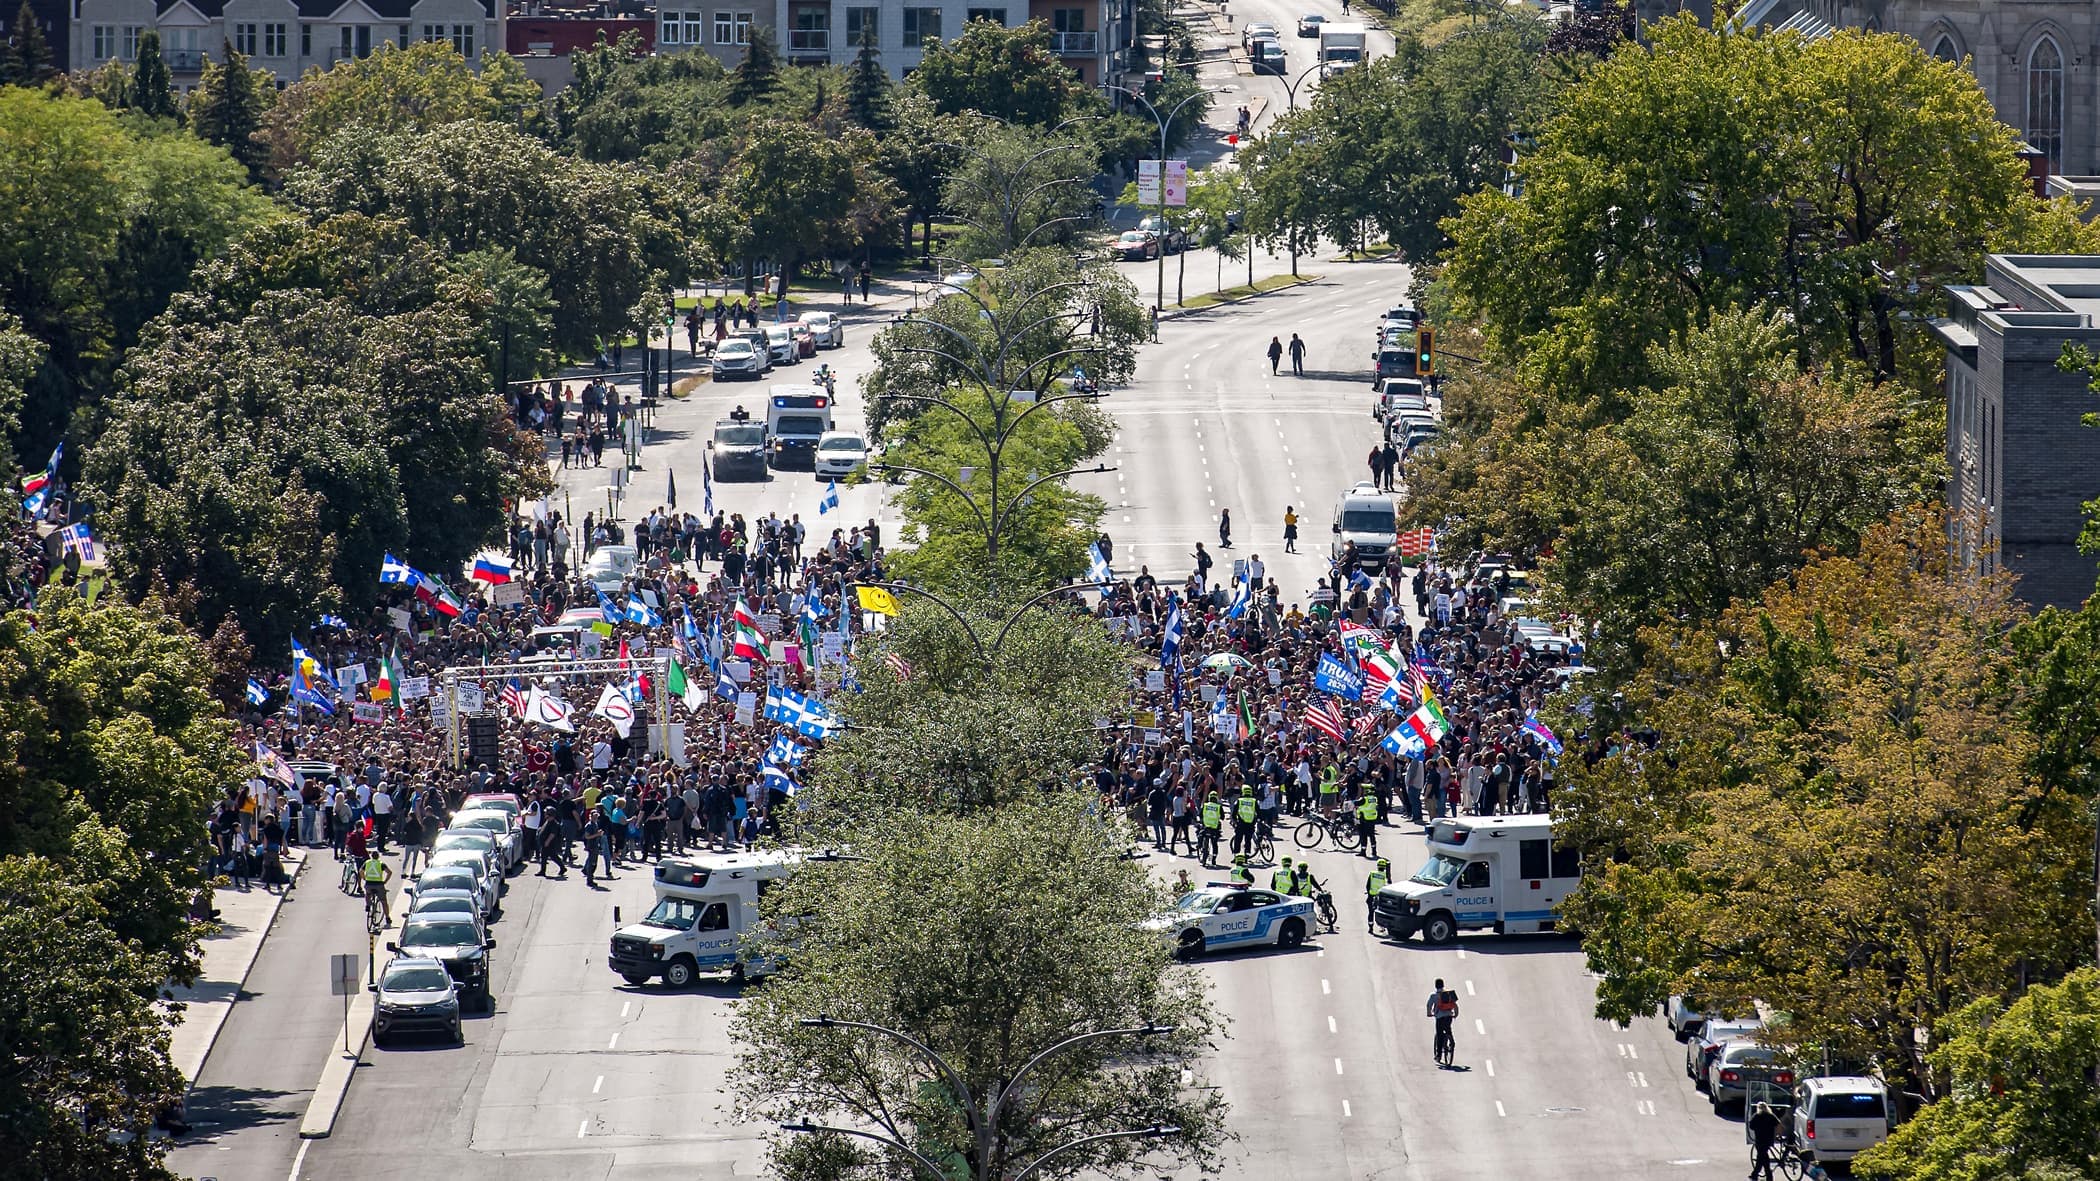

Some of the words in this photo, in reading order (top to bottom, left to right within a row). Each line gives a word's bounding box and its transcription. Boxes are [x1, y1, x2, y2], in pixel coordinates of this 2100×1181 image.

[1326, 678, 1347, 692] 2020
[1456, 896, 1488, 905] POLICE
[1221, 920, 1249, 932] POLICE
[699, 939, 729, 950] POLICE
